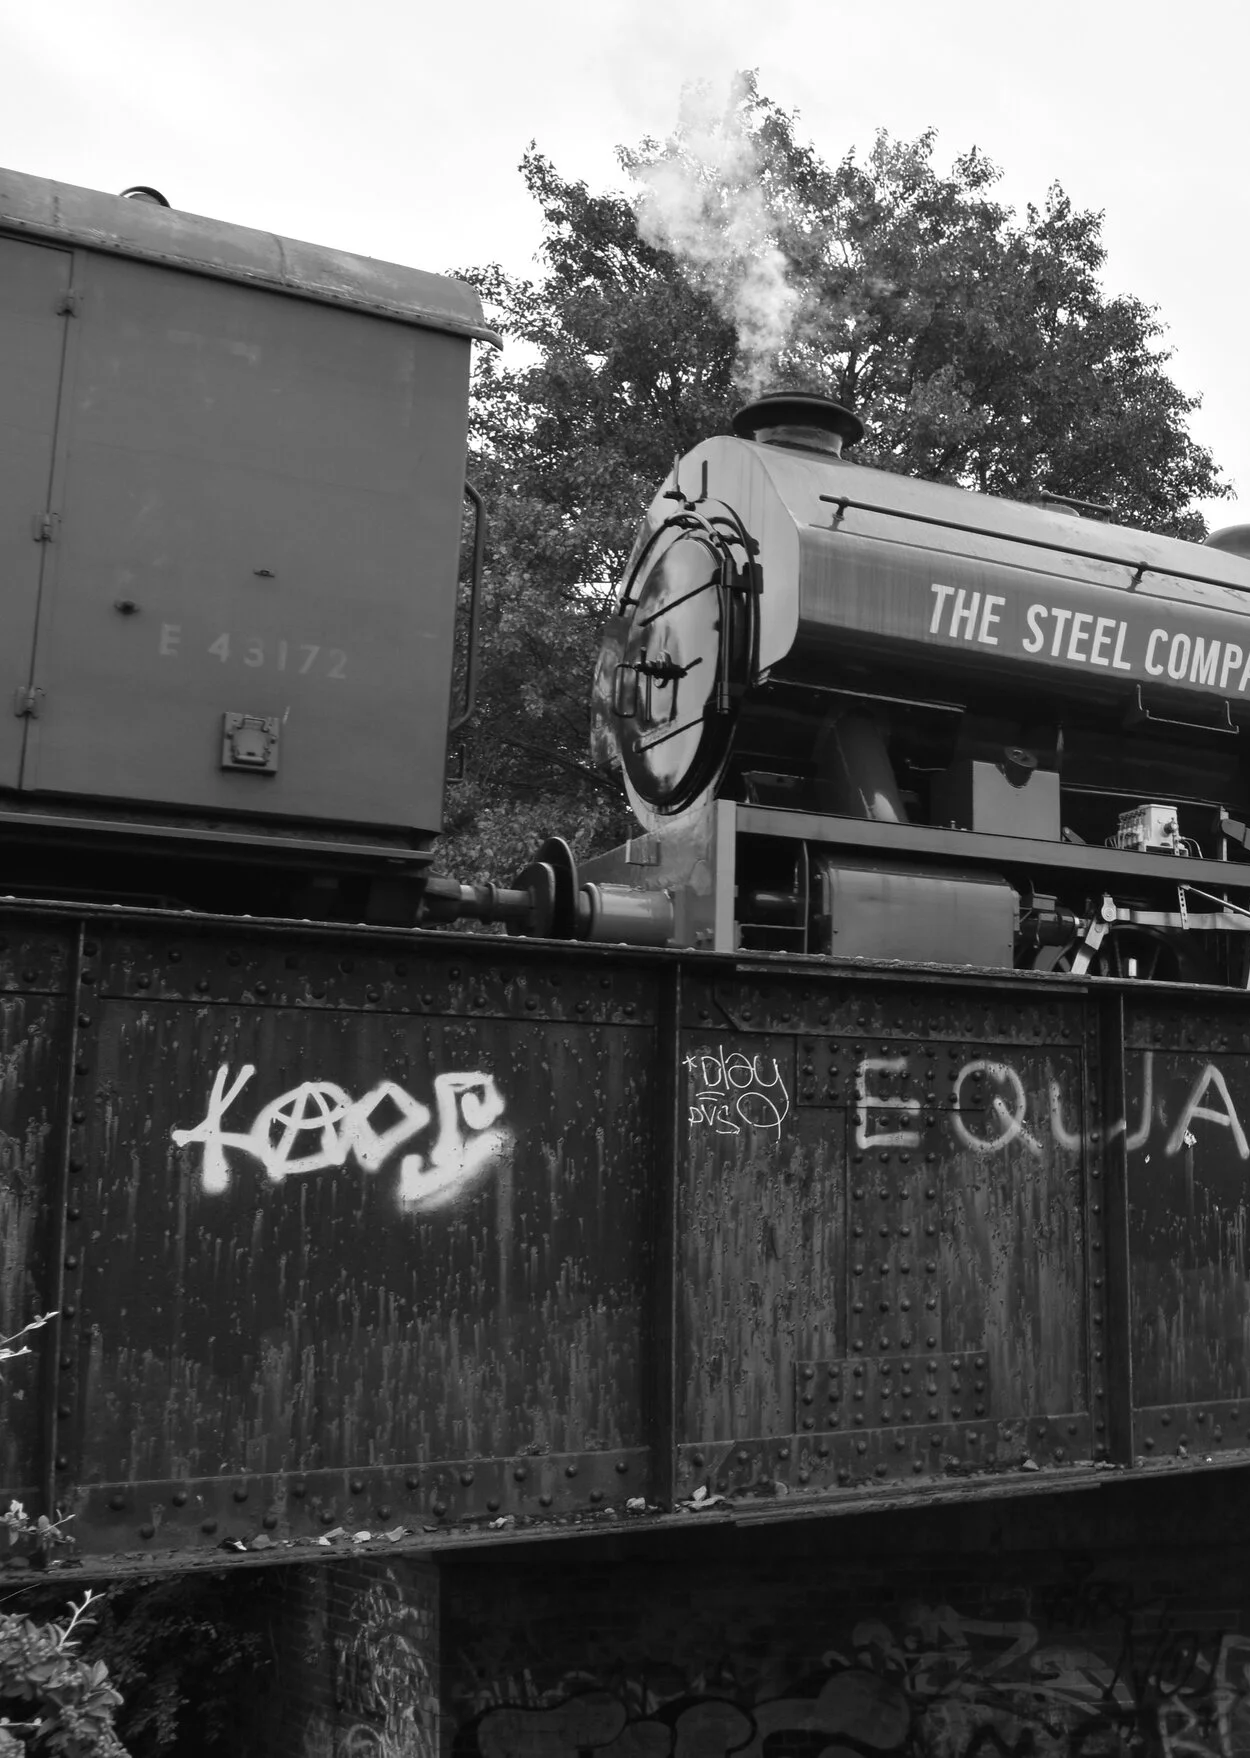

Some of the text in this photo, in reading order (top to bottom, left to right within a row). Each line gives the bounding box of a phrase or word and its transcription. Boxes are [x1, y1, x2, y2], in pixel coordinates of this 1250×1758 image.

[158, 622, 349, 680] E 43172
[930, 584, 1006, 645] THE
[1022, 604, 1131, 670] STEEL
